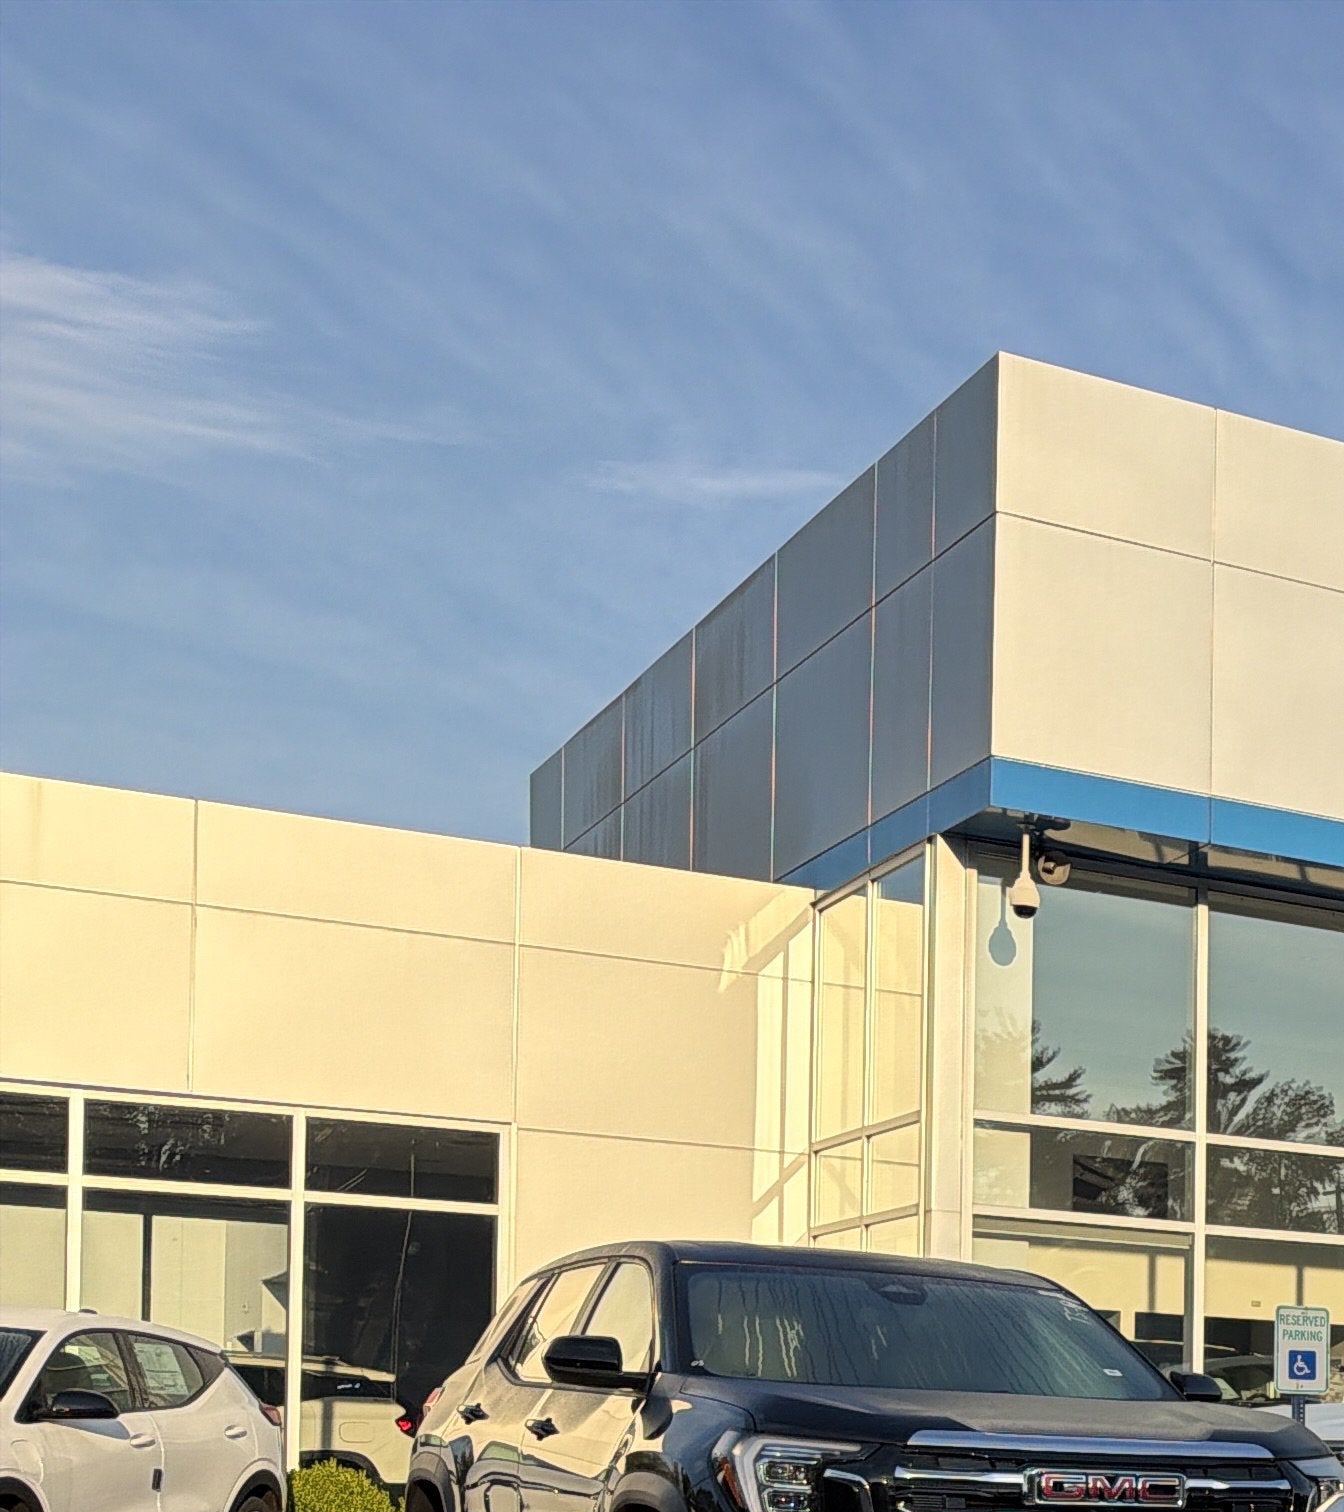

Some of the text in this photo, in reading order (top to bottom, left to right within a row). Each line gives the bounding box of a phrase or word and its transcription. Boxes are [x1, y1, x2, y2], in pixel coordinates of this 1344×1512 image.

[1279, 1313, 1326, 1328] RESERVED
[1282, 1328, 1323, 1342] PARKING
[1041, 1472, 1180, 1503] GMC
